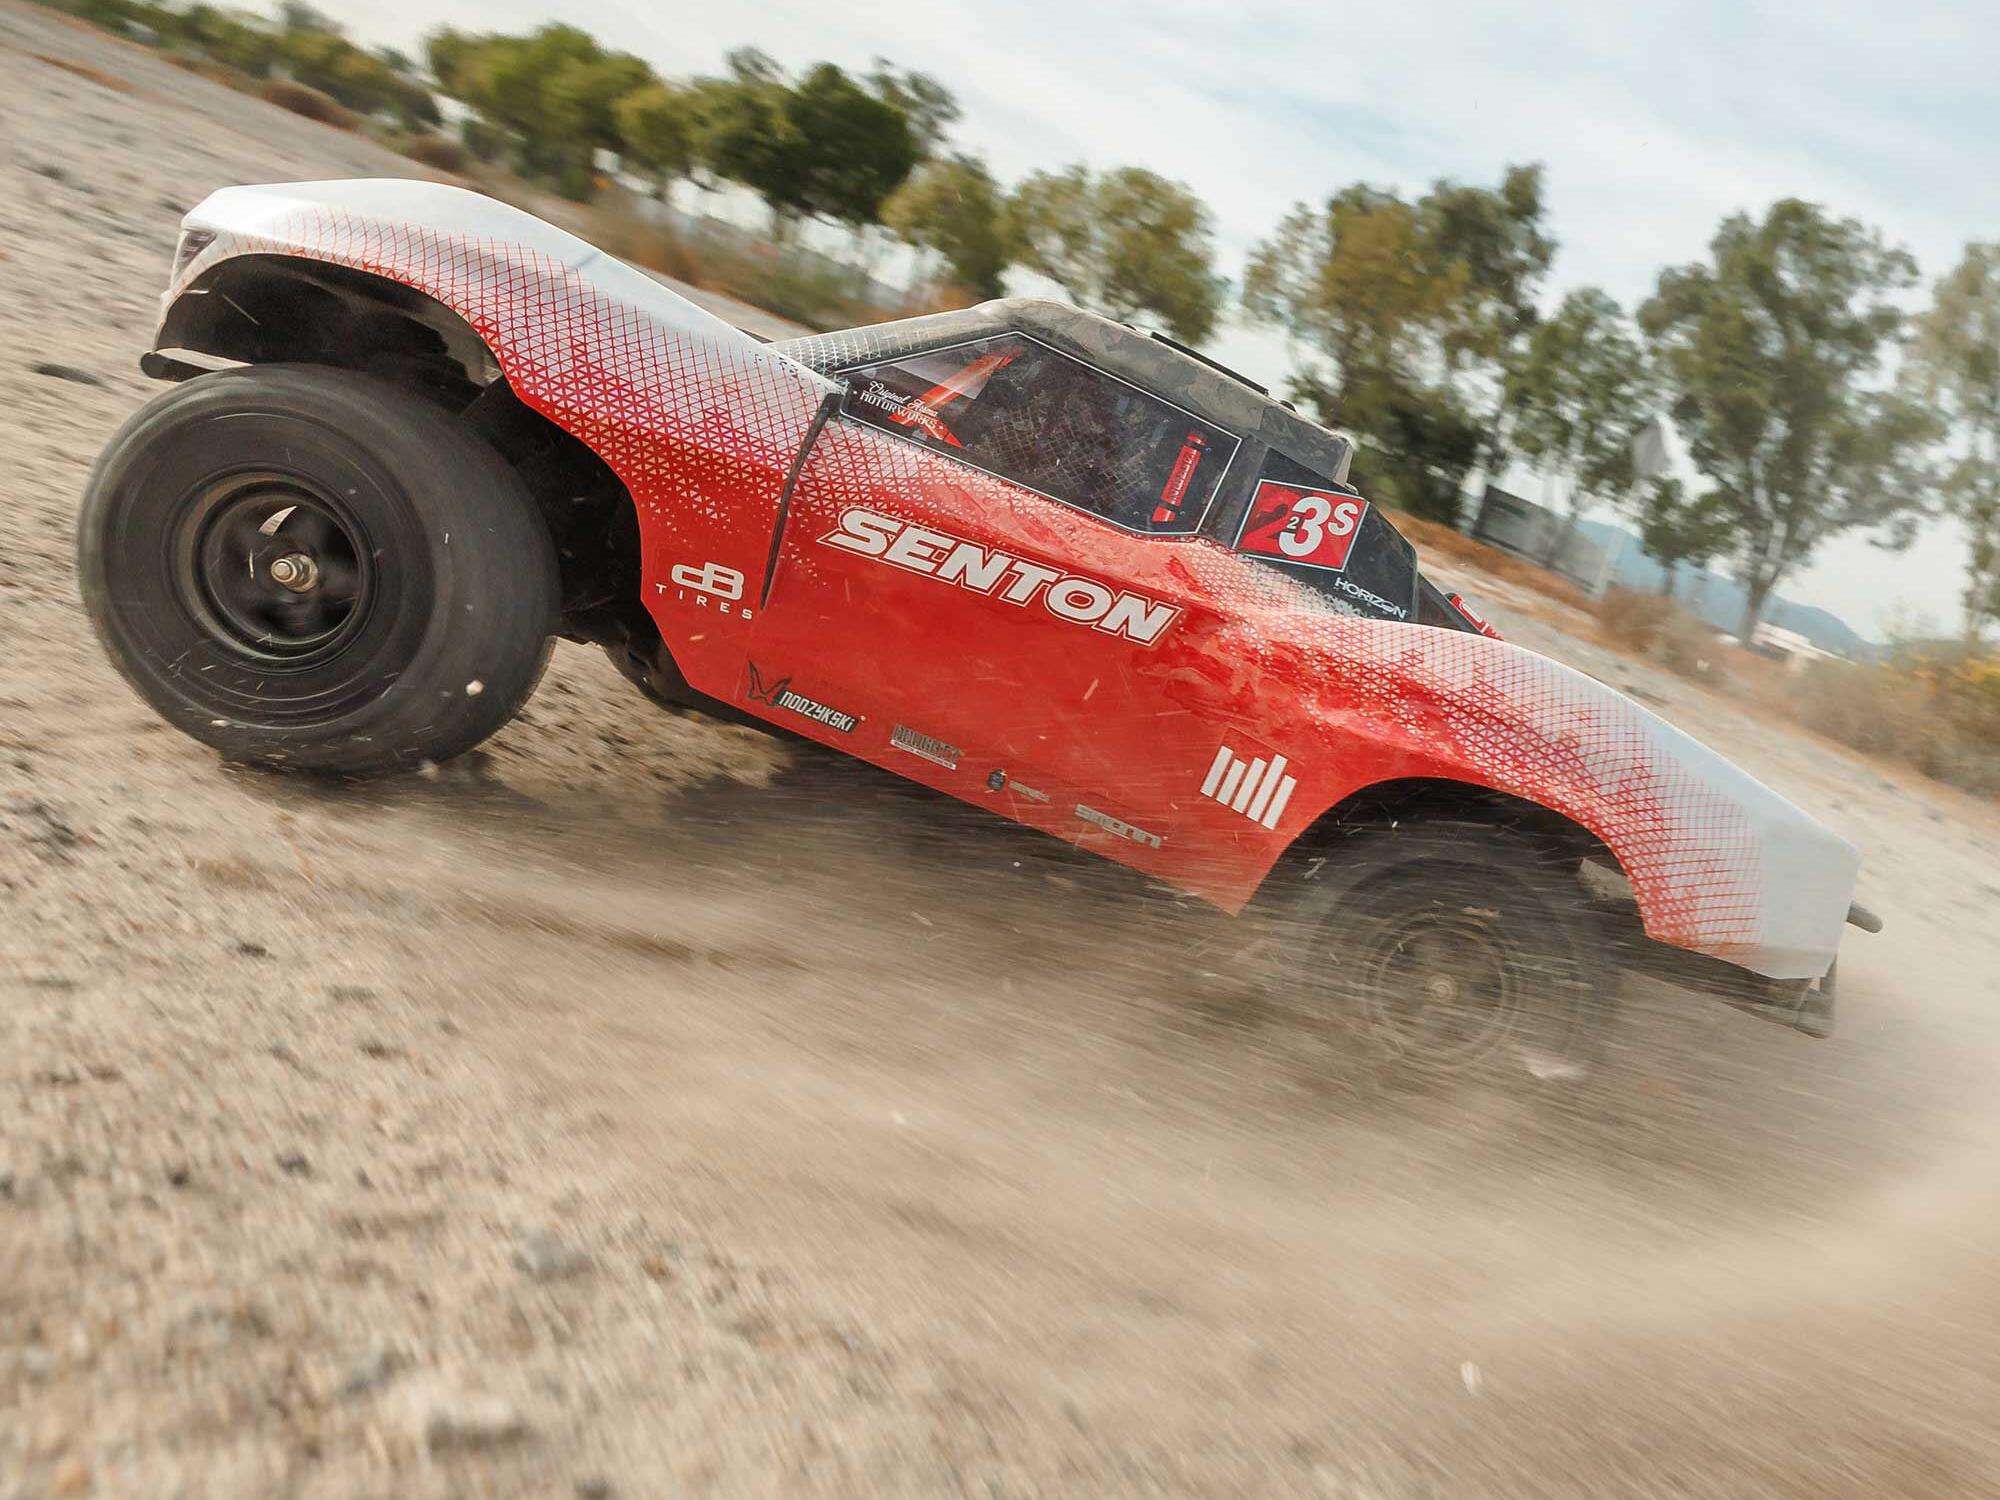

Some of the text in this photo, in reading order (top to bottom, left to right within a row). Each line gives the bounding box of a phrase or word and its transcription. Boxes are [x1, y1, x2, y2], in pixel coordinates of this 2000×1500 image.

[860, 391, 936, 429] MOTORWORKS
[816, 504, 1184, 647] SENTON
[656, 583, 753, 620] TIRES
[1334, 577, 1407, 619] HORIZON
